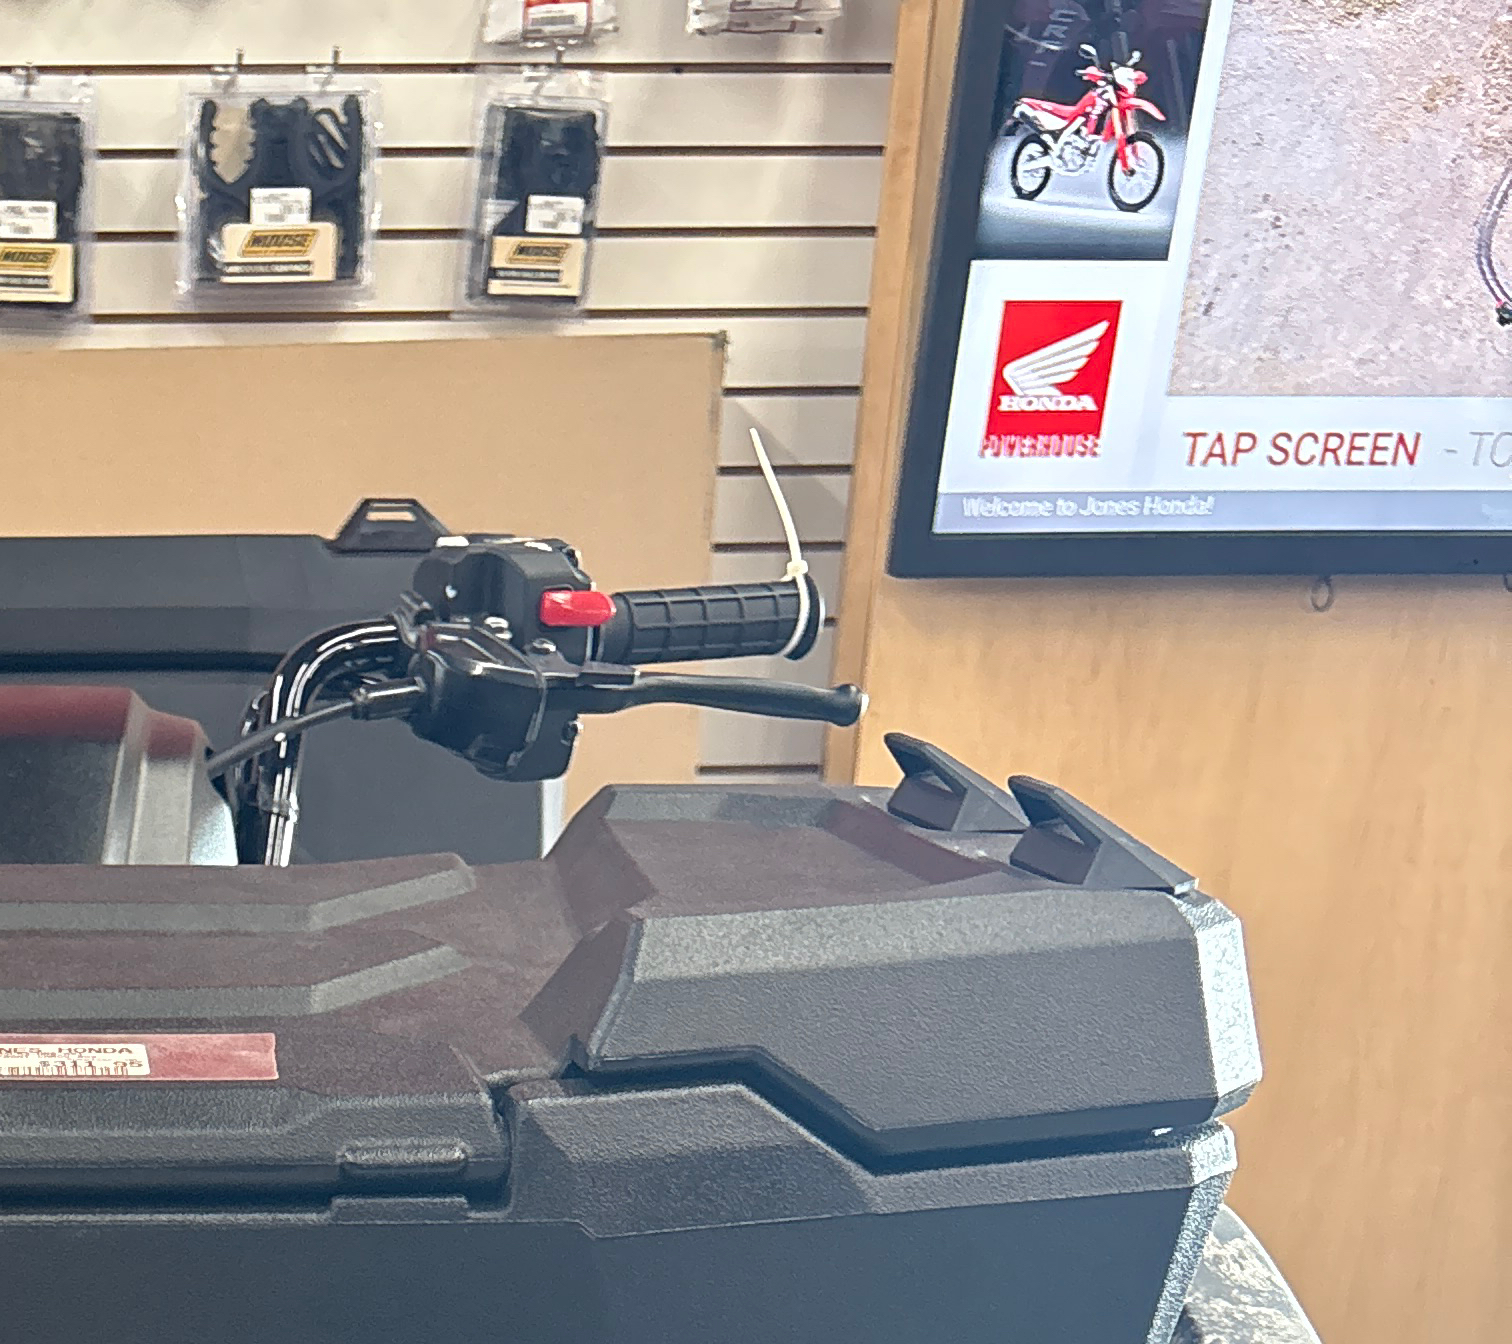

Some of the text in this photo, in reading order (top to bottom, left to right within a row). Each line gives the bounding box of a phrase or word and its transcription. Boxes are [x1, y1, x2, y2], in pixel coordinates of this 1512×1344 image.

[998, 395, 1098, 412] HONDA
[979, 434, 1100, 458] POWERHOUSE
[1183, 431, 1257, 467] TAP
[1267, 431, 1422, 467] SCREEN
[963, 495, 1215, 517] Welcome to Jones Honda!
